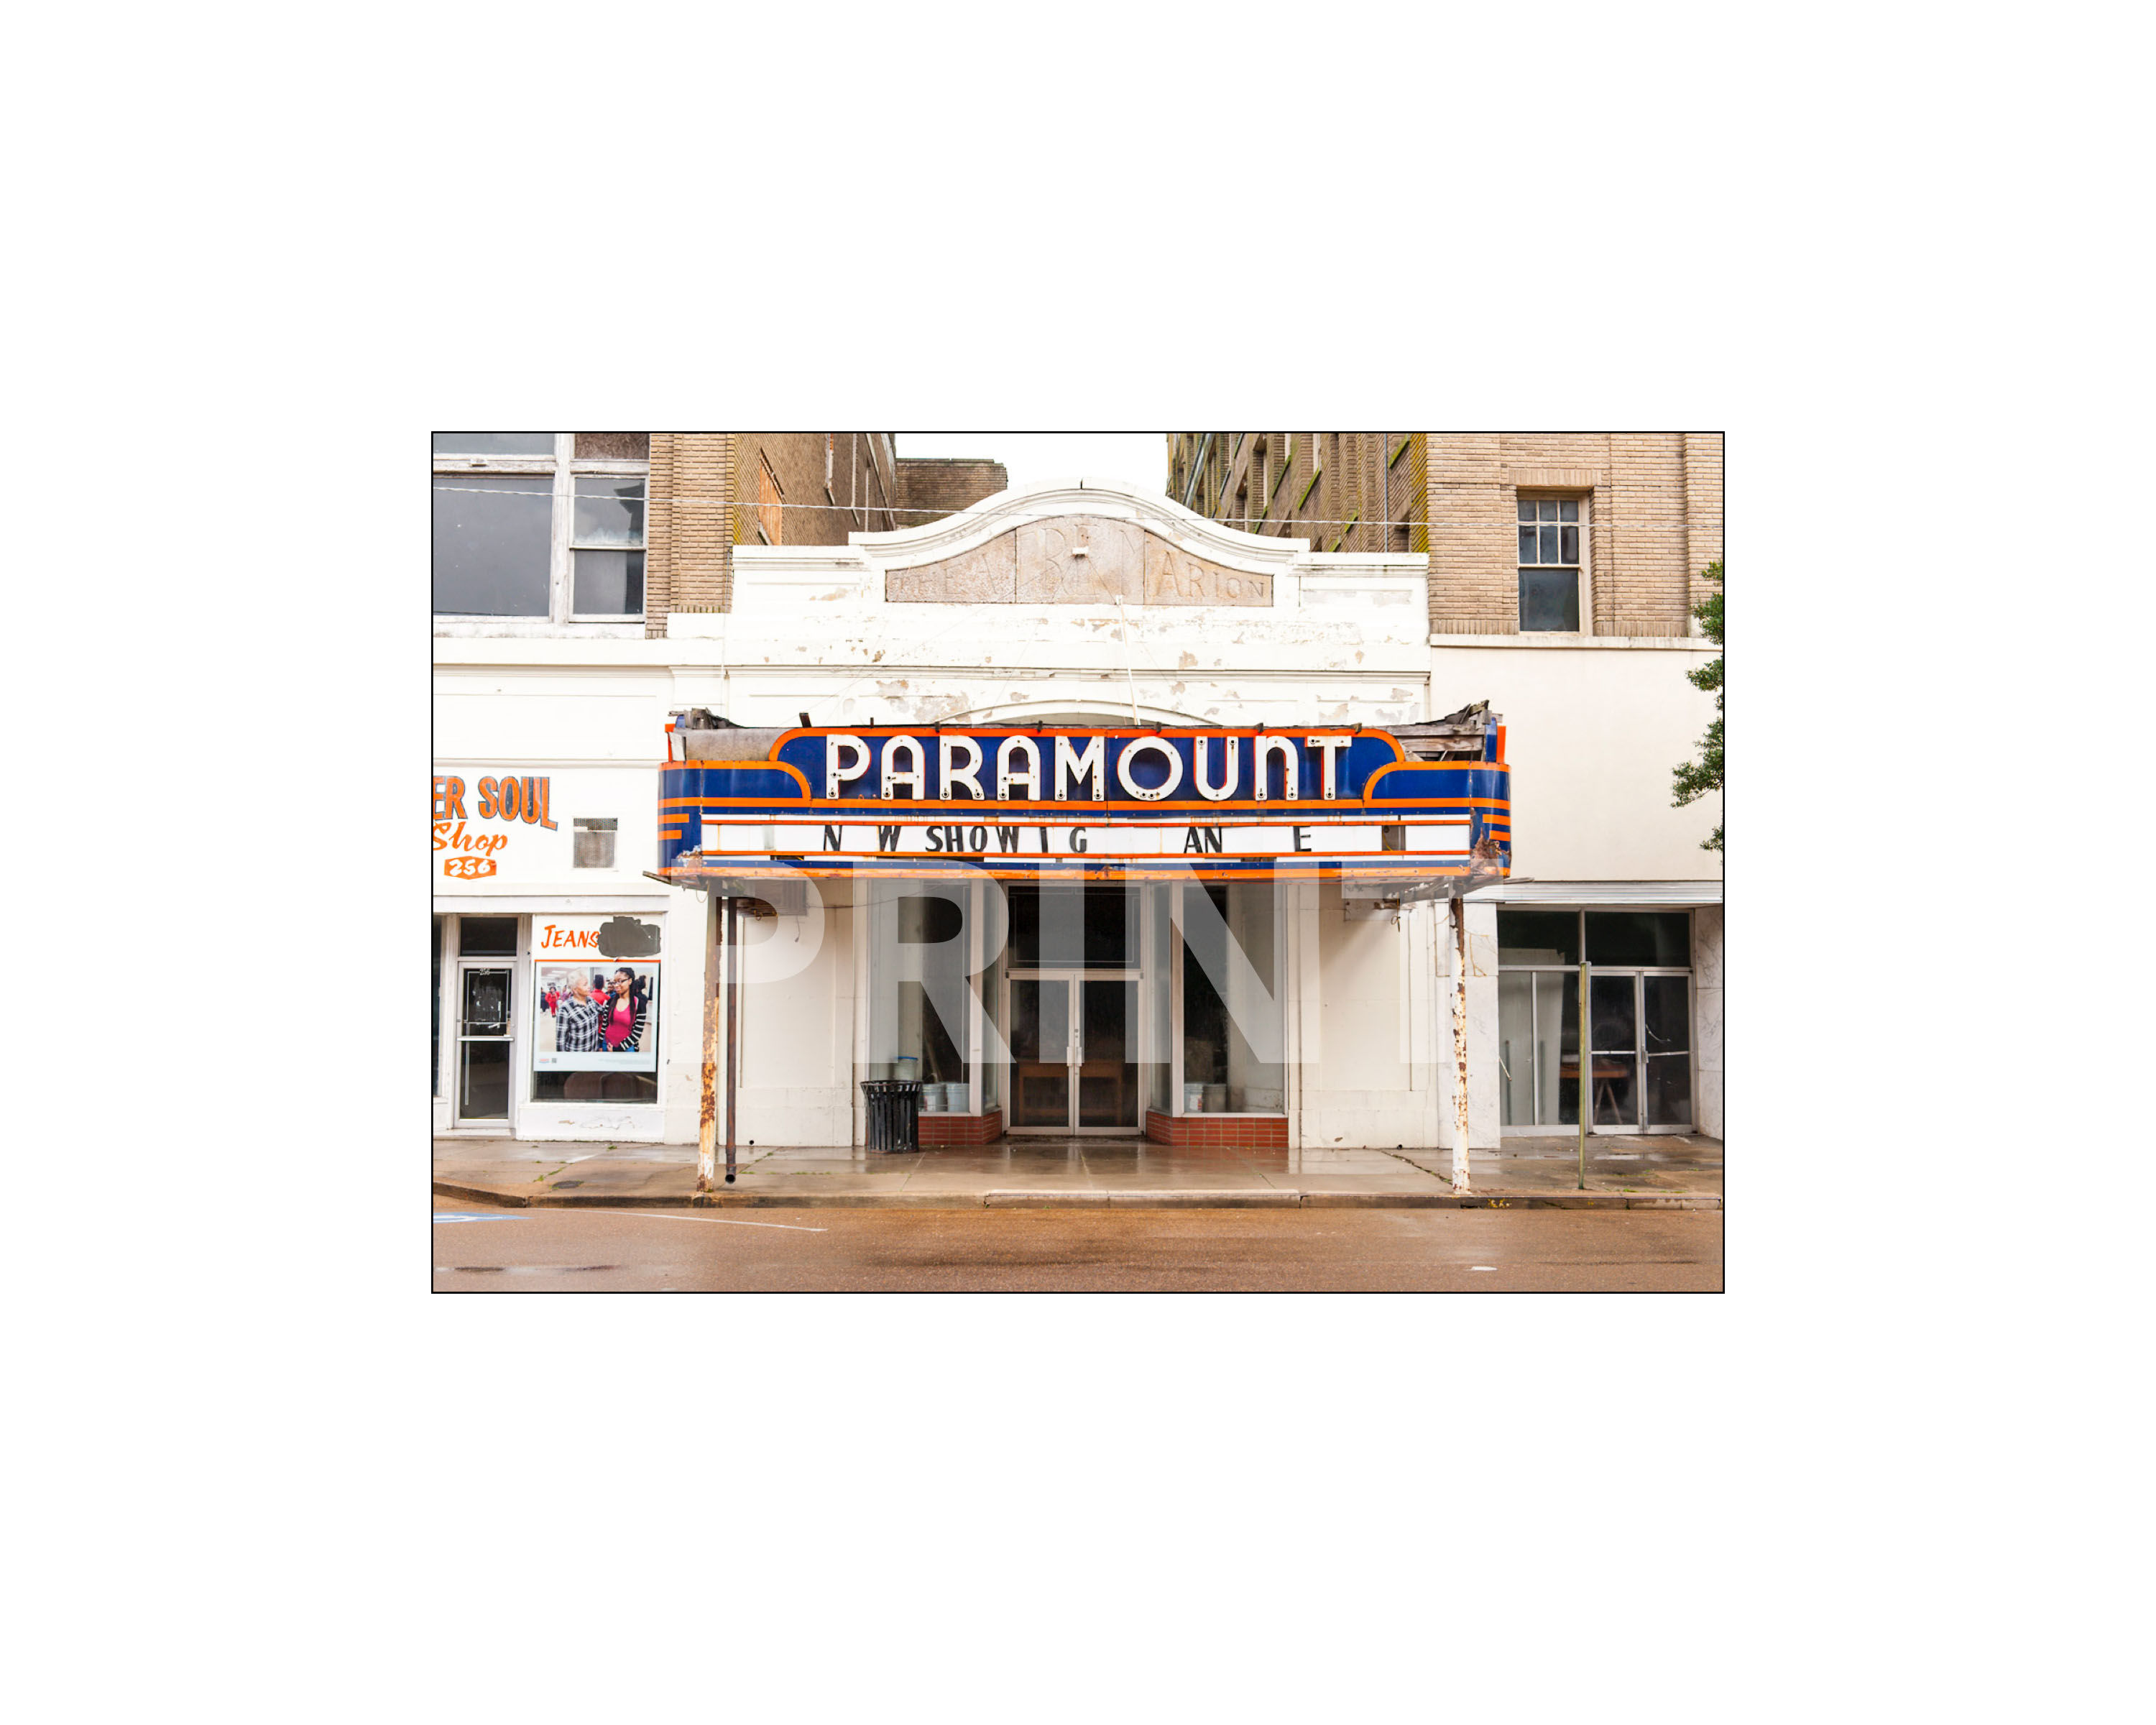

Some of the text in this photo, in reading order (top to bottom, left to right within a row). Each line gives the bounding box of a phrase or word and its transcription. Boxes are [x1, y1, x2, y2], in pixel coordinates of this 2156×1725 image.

[825, 734, 1352, 801] PARAMOUNT
[478, 776, 558, 832] SOUL
[433, 821, 508, 857] Shop
[1184, 826, 1222, 854] AN
[448, 859, 491, 877] 256
[540, 924, 600, 949] JEANS
